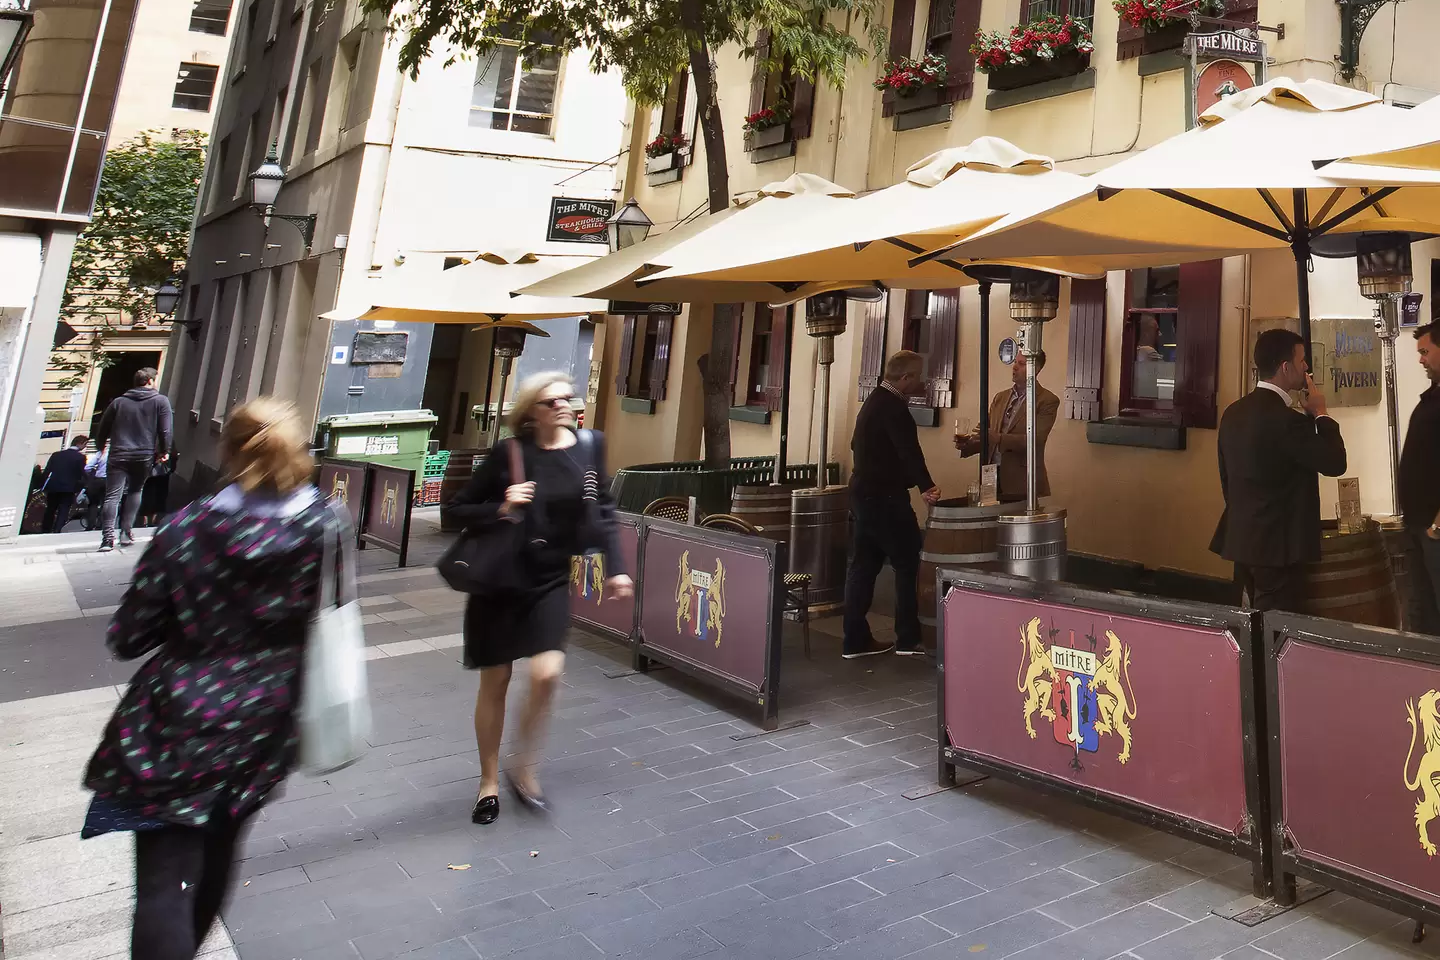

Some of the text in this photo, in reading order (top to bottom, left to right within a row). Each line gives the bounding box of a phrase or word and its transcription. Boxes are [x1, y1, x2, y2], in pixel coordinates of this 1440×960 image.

[1197, 33, 1257, 53] THE MITRE
[556, 202, 609, 217] THE MITRE
[555, 217, 605, 229] STEAKHOUSE
[581, 222, 604, 230] GRILL
[1330, 367, 1378, 393] TAVERN
